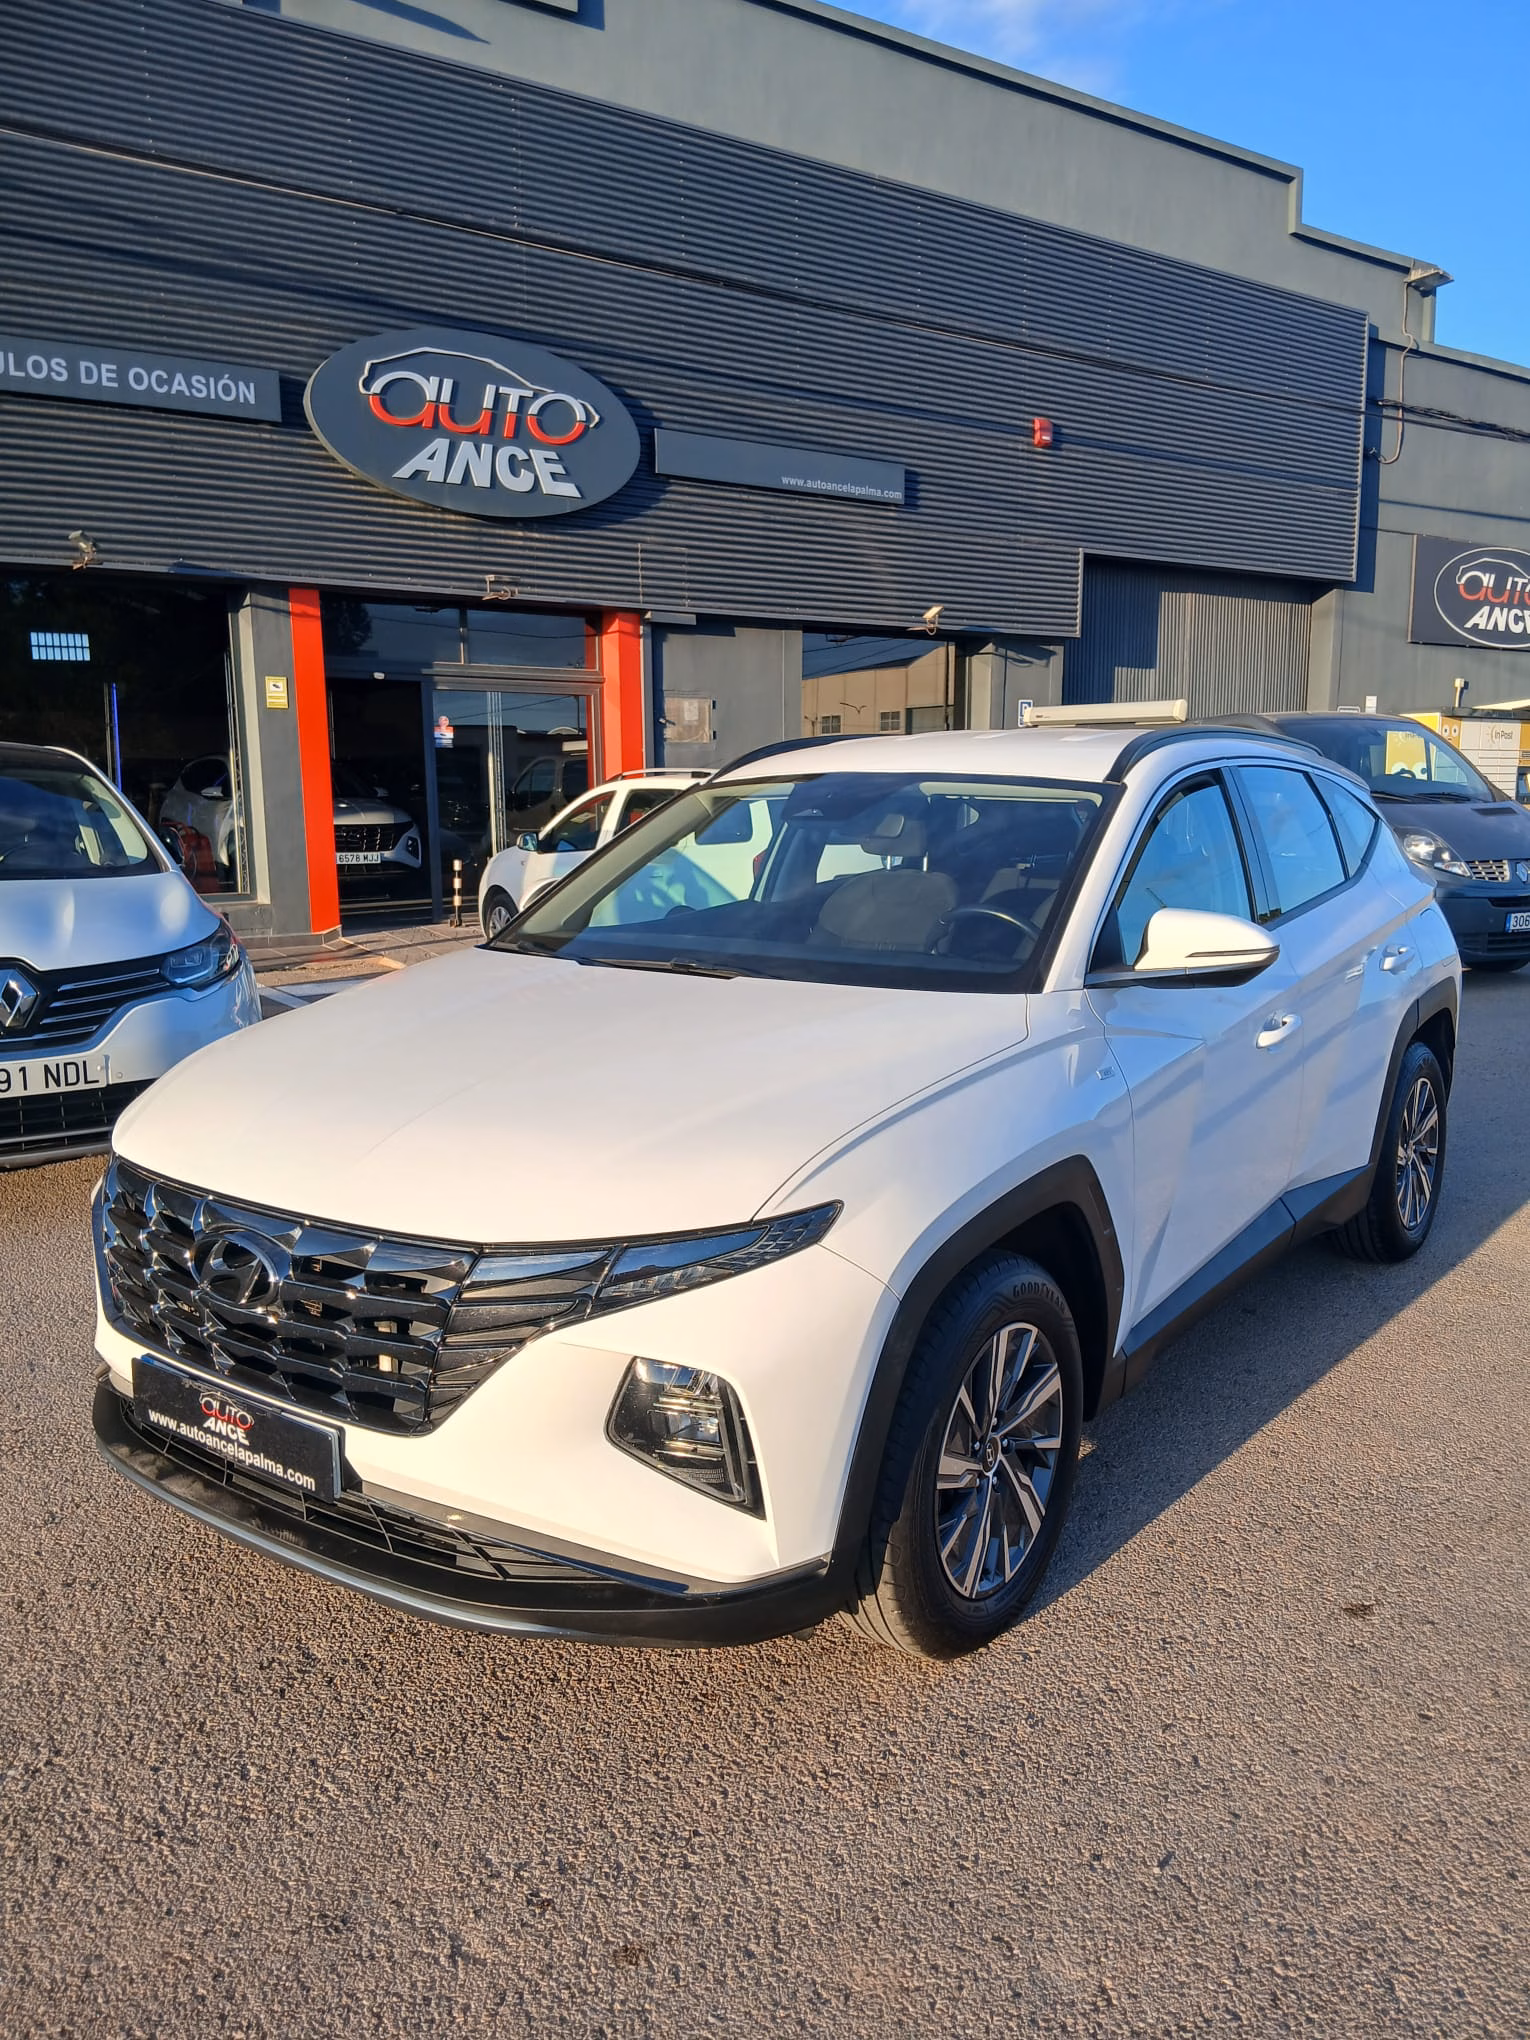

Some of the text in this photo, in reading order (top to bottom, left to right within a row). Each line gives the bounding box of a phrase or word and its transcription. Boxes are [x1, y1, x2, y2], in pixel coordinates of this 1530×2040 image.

[0, 352, 256, 404] LOS DE OCASIÓN
[392, 438, 583, 498] ANCE
[781, 476, 903, 499] www.autoancelapalma.com
[339, 854, 361, 863] 6578
[0, 1060, 99, 1092] 91 NDL
[203, 1417, 250, 1446] ANCE
[148, 1408, 316, 1492] www.autoancelapalma.com
